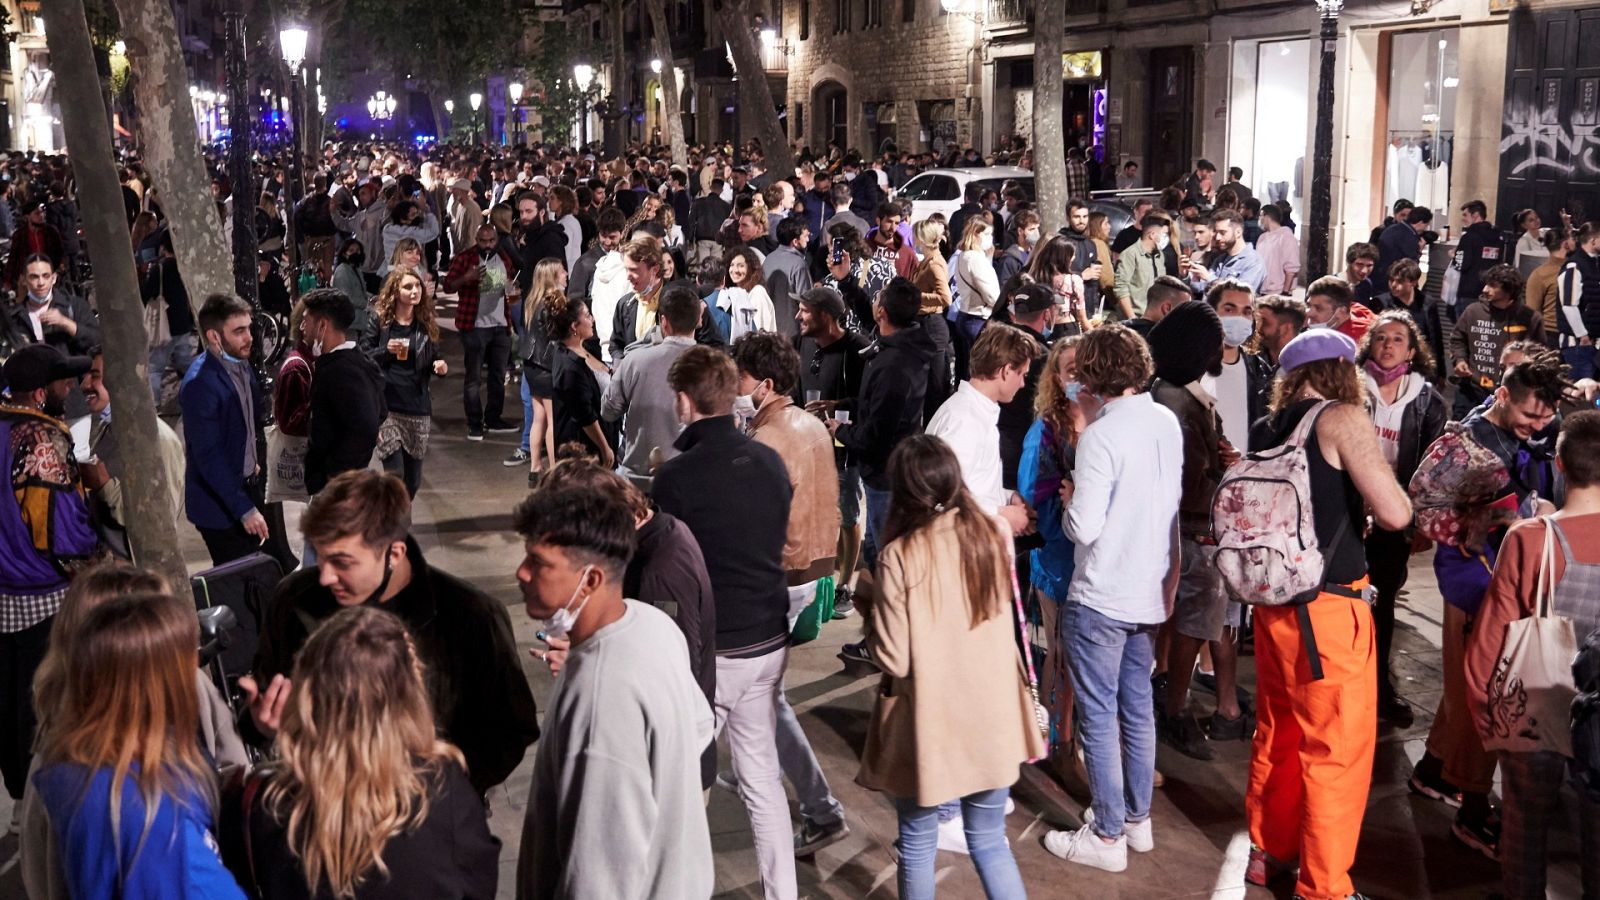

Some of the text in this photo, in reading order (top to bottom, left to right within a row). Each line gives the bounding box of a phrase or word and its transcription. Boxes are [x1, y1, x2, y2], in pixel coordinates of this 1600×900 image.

[1477, 320, 1495, 328] THIS
[1471, 326, 1502, 335] ENERGY
[1481, 334, 1488, 342] IS
[1474, 340, 1496, 349] GOOD
[1478, 348, 1492, 356] FOR
[1474, 354, 1495, 363] YOUR
